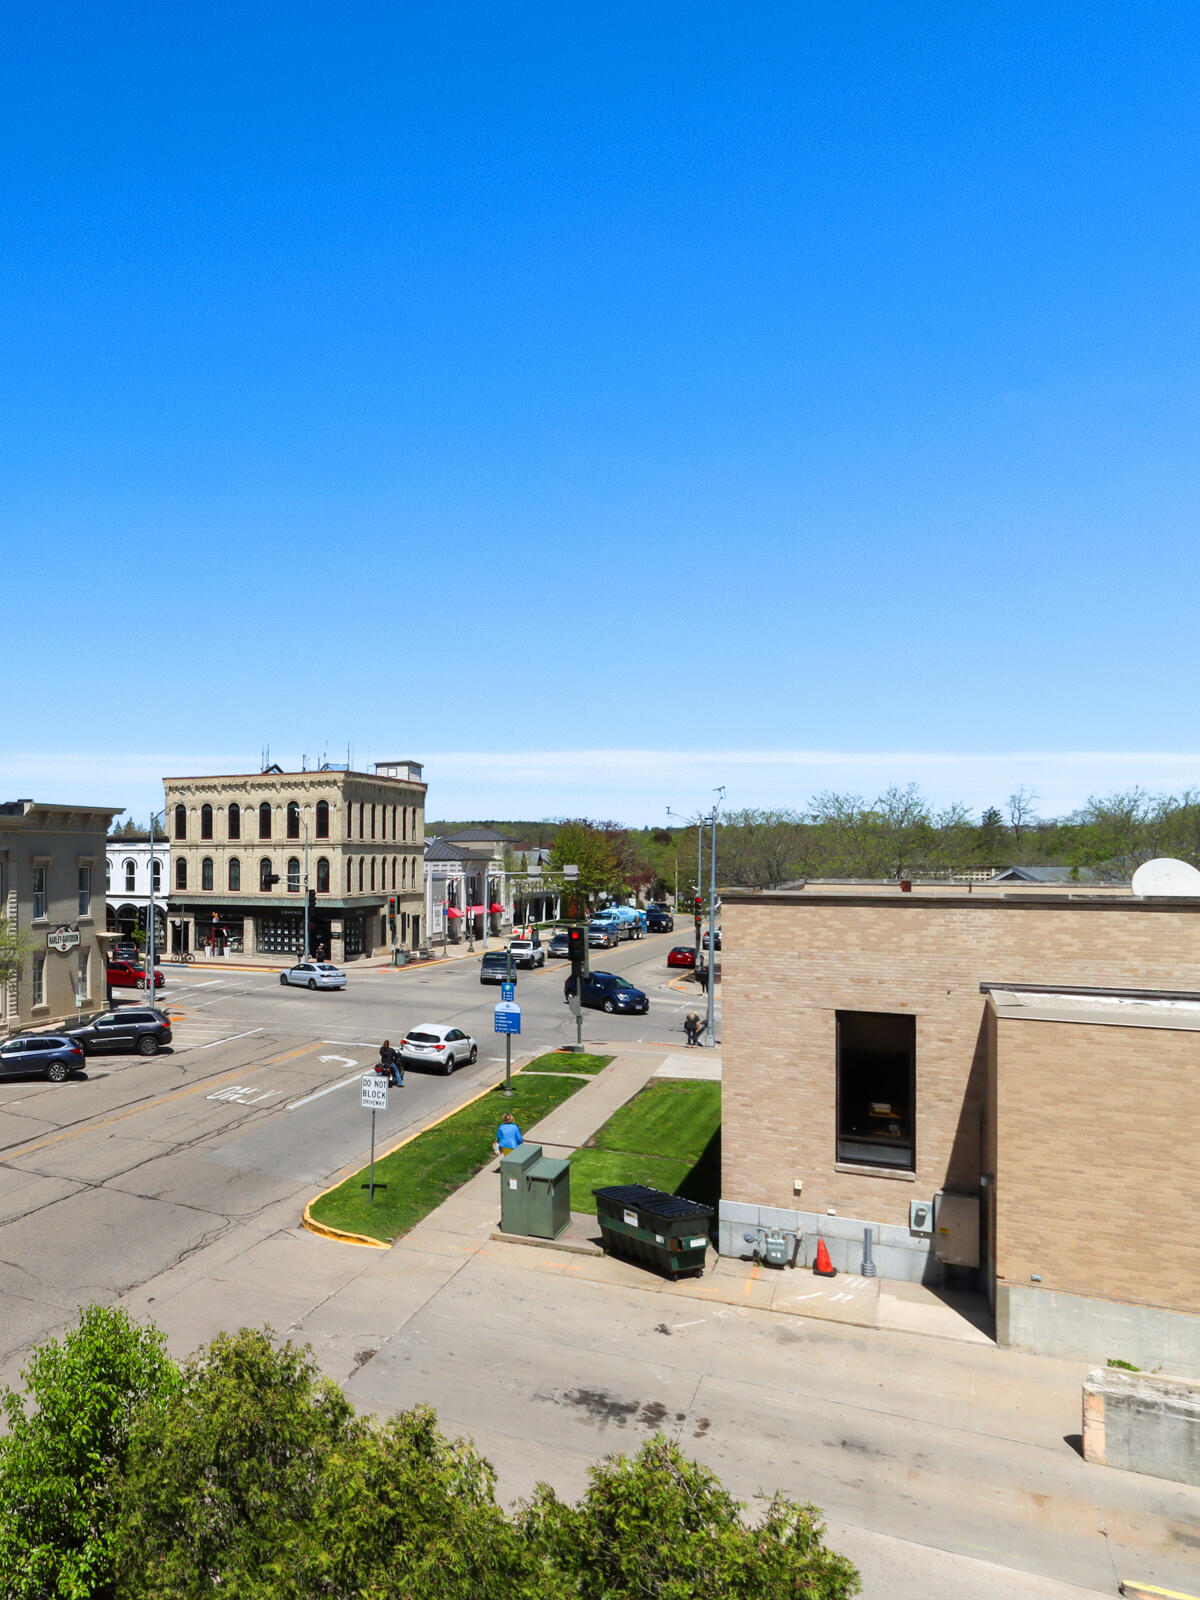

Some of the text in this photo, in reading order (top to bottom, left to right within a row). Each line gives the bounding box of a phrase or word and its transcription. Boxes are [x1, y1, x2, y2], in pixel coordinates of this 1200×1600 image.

[362, 1079, 386, 1089] DO NOT
[206, 1086, 282, 1105] ONLY
[362, 1089, 386, 1099] BLOCK
